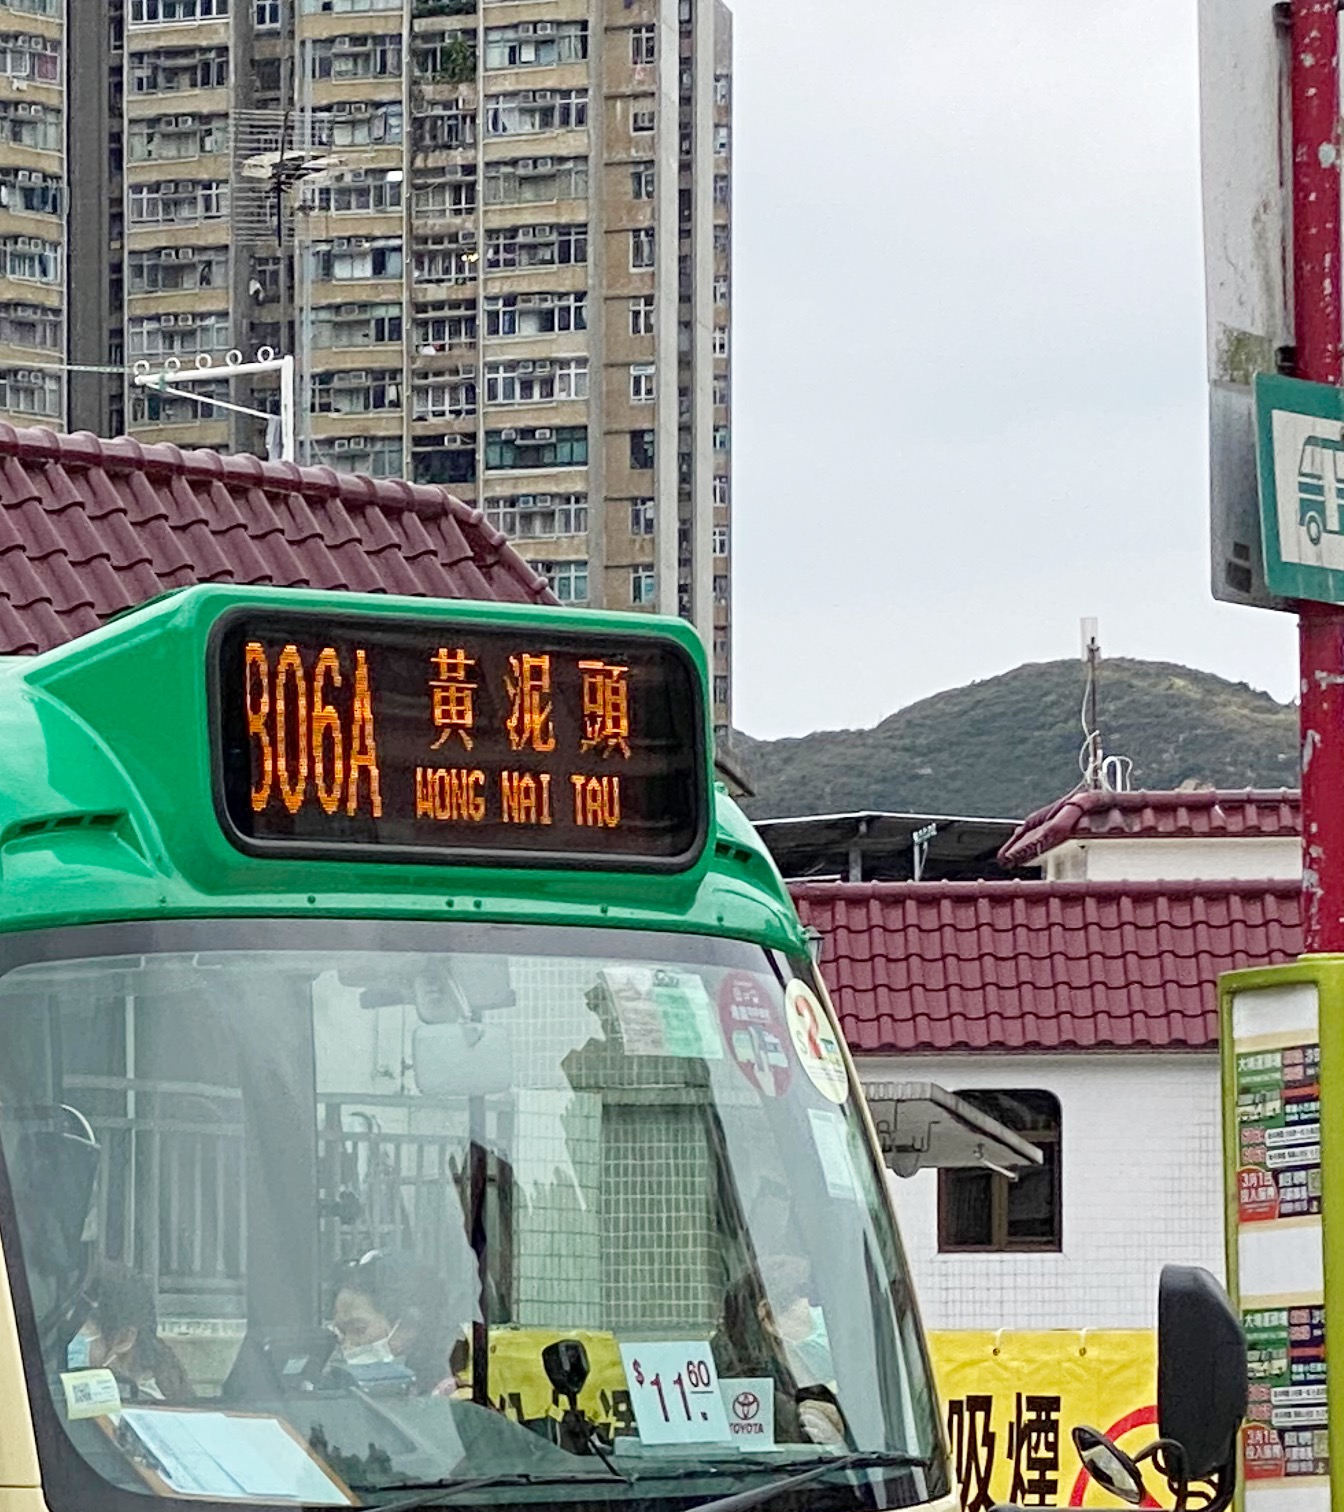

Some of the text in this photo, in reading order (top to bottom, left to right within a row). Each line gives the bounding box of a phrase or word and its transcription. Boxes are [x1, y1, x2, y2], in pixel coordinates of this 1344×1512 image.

[245, 642, 382, 818] 806A
[428, 647, 631, 760] 黃泥頭
[415, 767, 622, 828] WONG NAI TAU
